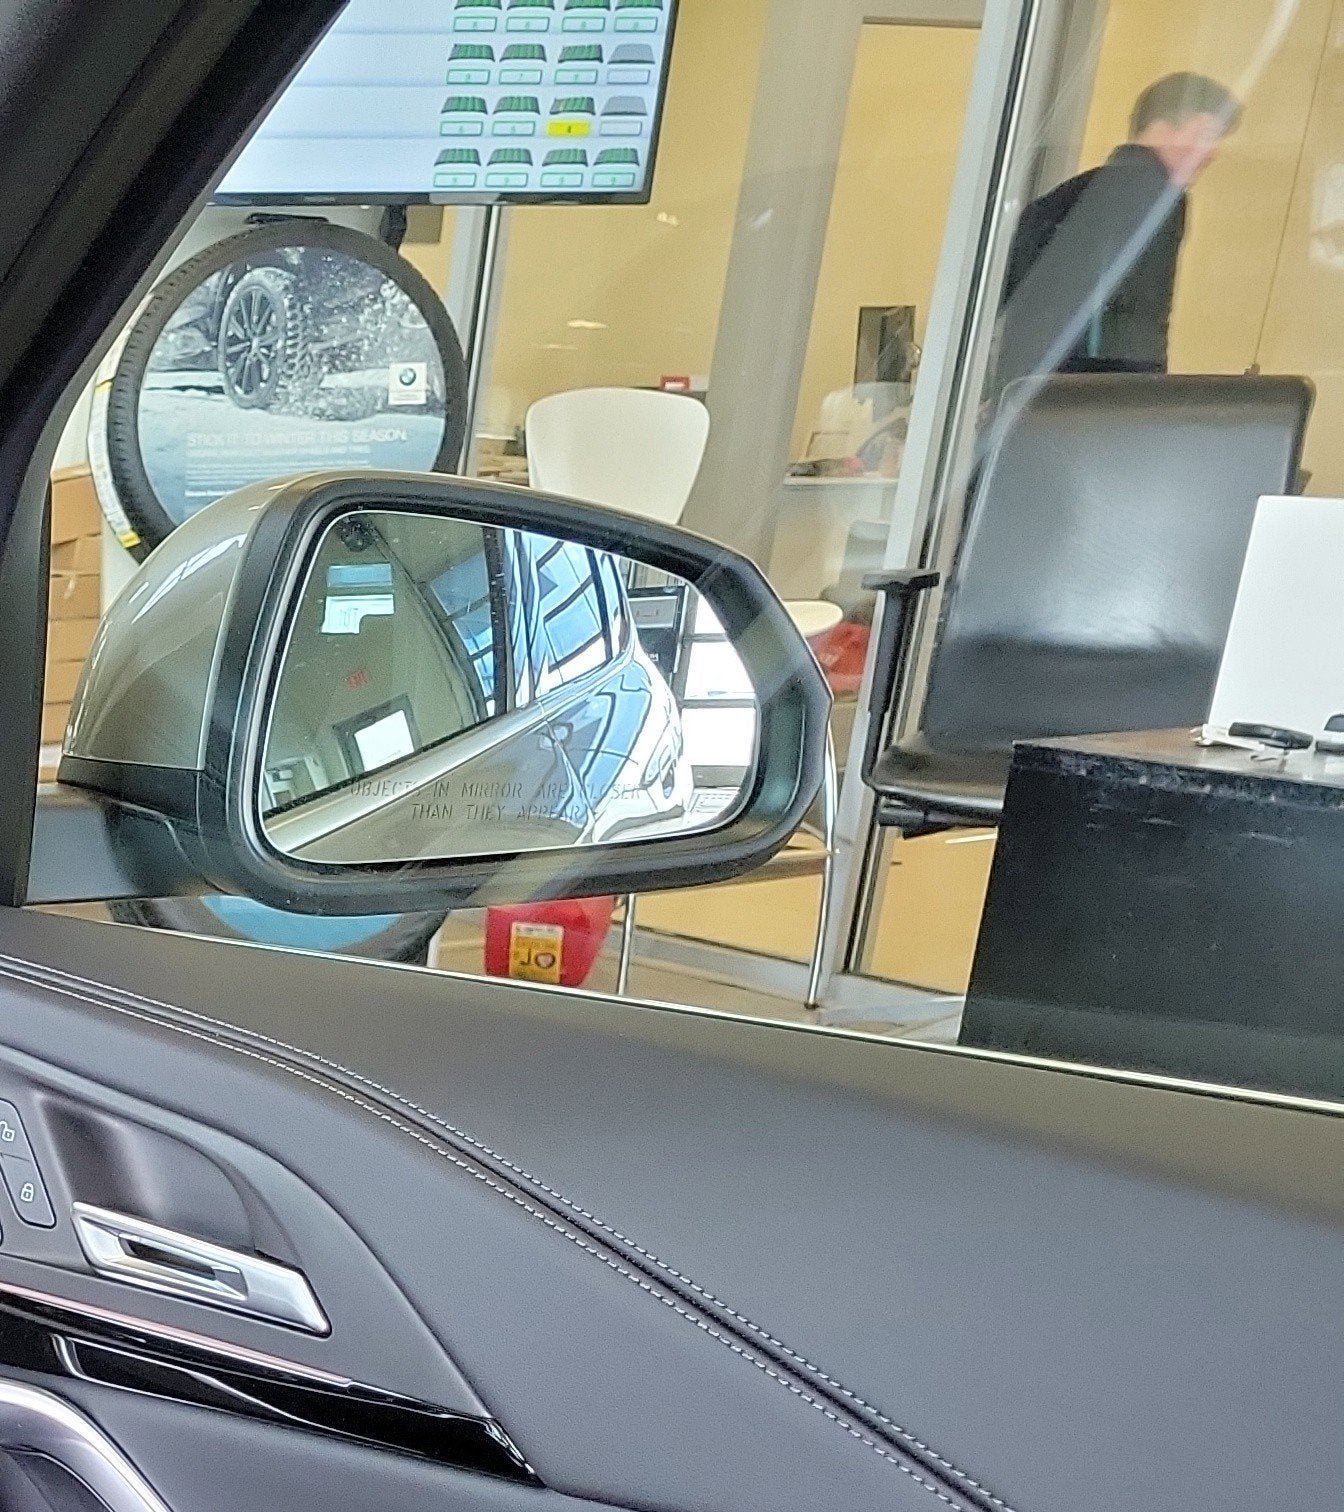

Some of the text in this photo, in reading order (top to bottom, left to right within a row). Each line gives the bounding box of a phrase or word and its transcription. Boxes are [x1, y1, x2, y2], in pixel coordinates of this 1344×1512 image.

[350, 780, 420, 797] OBJECTS
[433, 781, 449, 797] IN
[462, 781, 522, 797] MIRROR
[538, 782, 567, 798] ARE
[411, 803, 452, 819] THAN
[466, 804, 506, 819] THEY
